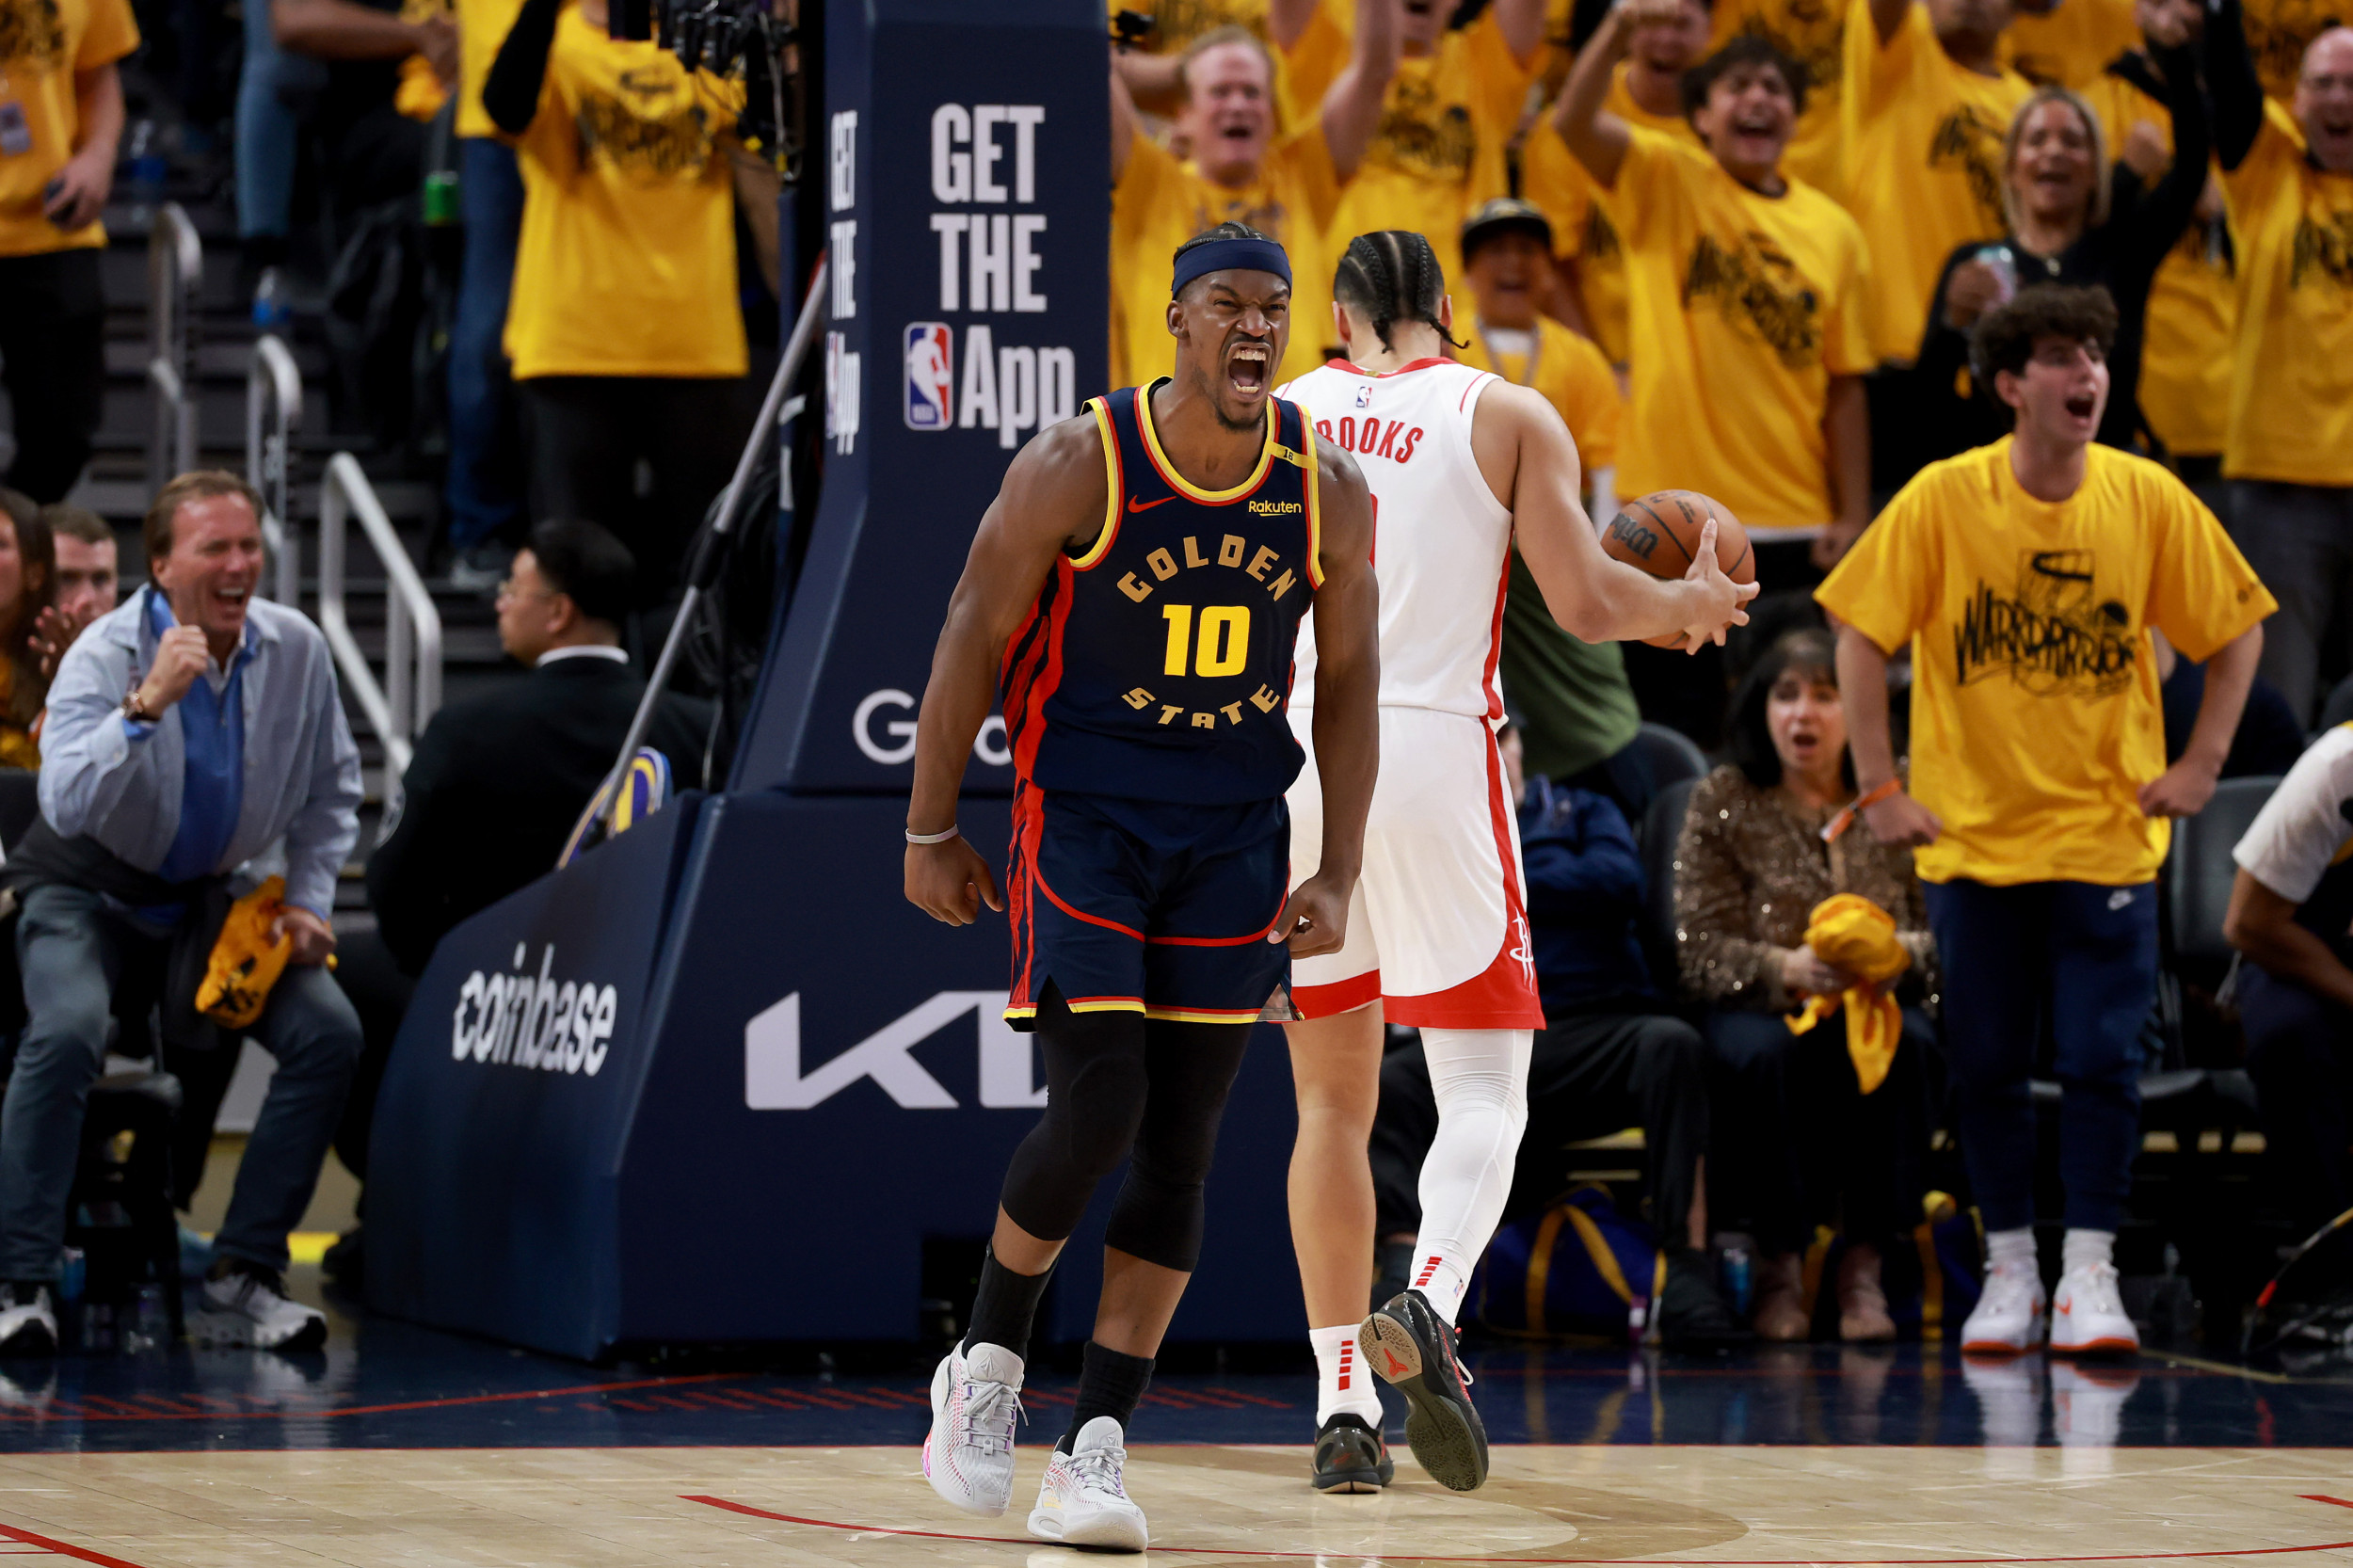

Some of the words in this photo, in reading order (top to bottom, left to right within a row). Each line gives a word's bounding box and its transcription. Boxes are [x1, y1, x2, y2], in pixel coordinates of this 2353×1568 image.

[930, 102, 1046, 204] GET
[929, 213, 1048, 313] THE
[958, 324, 1076, 449] App
[1283, 449, 1294, 461] 16
[1248, 500, 1302, 514] Rakuten
[1116, 534, 1297, 603] GOLDEN
[1161, 603, 1252, 679] 10
[1121, 682, 1281, 730] STATE
[452, 940, 617, 1077] coinbase
